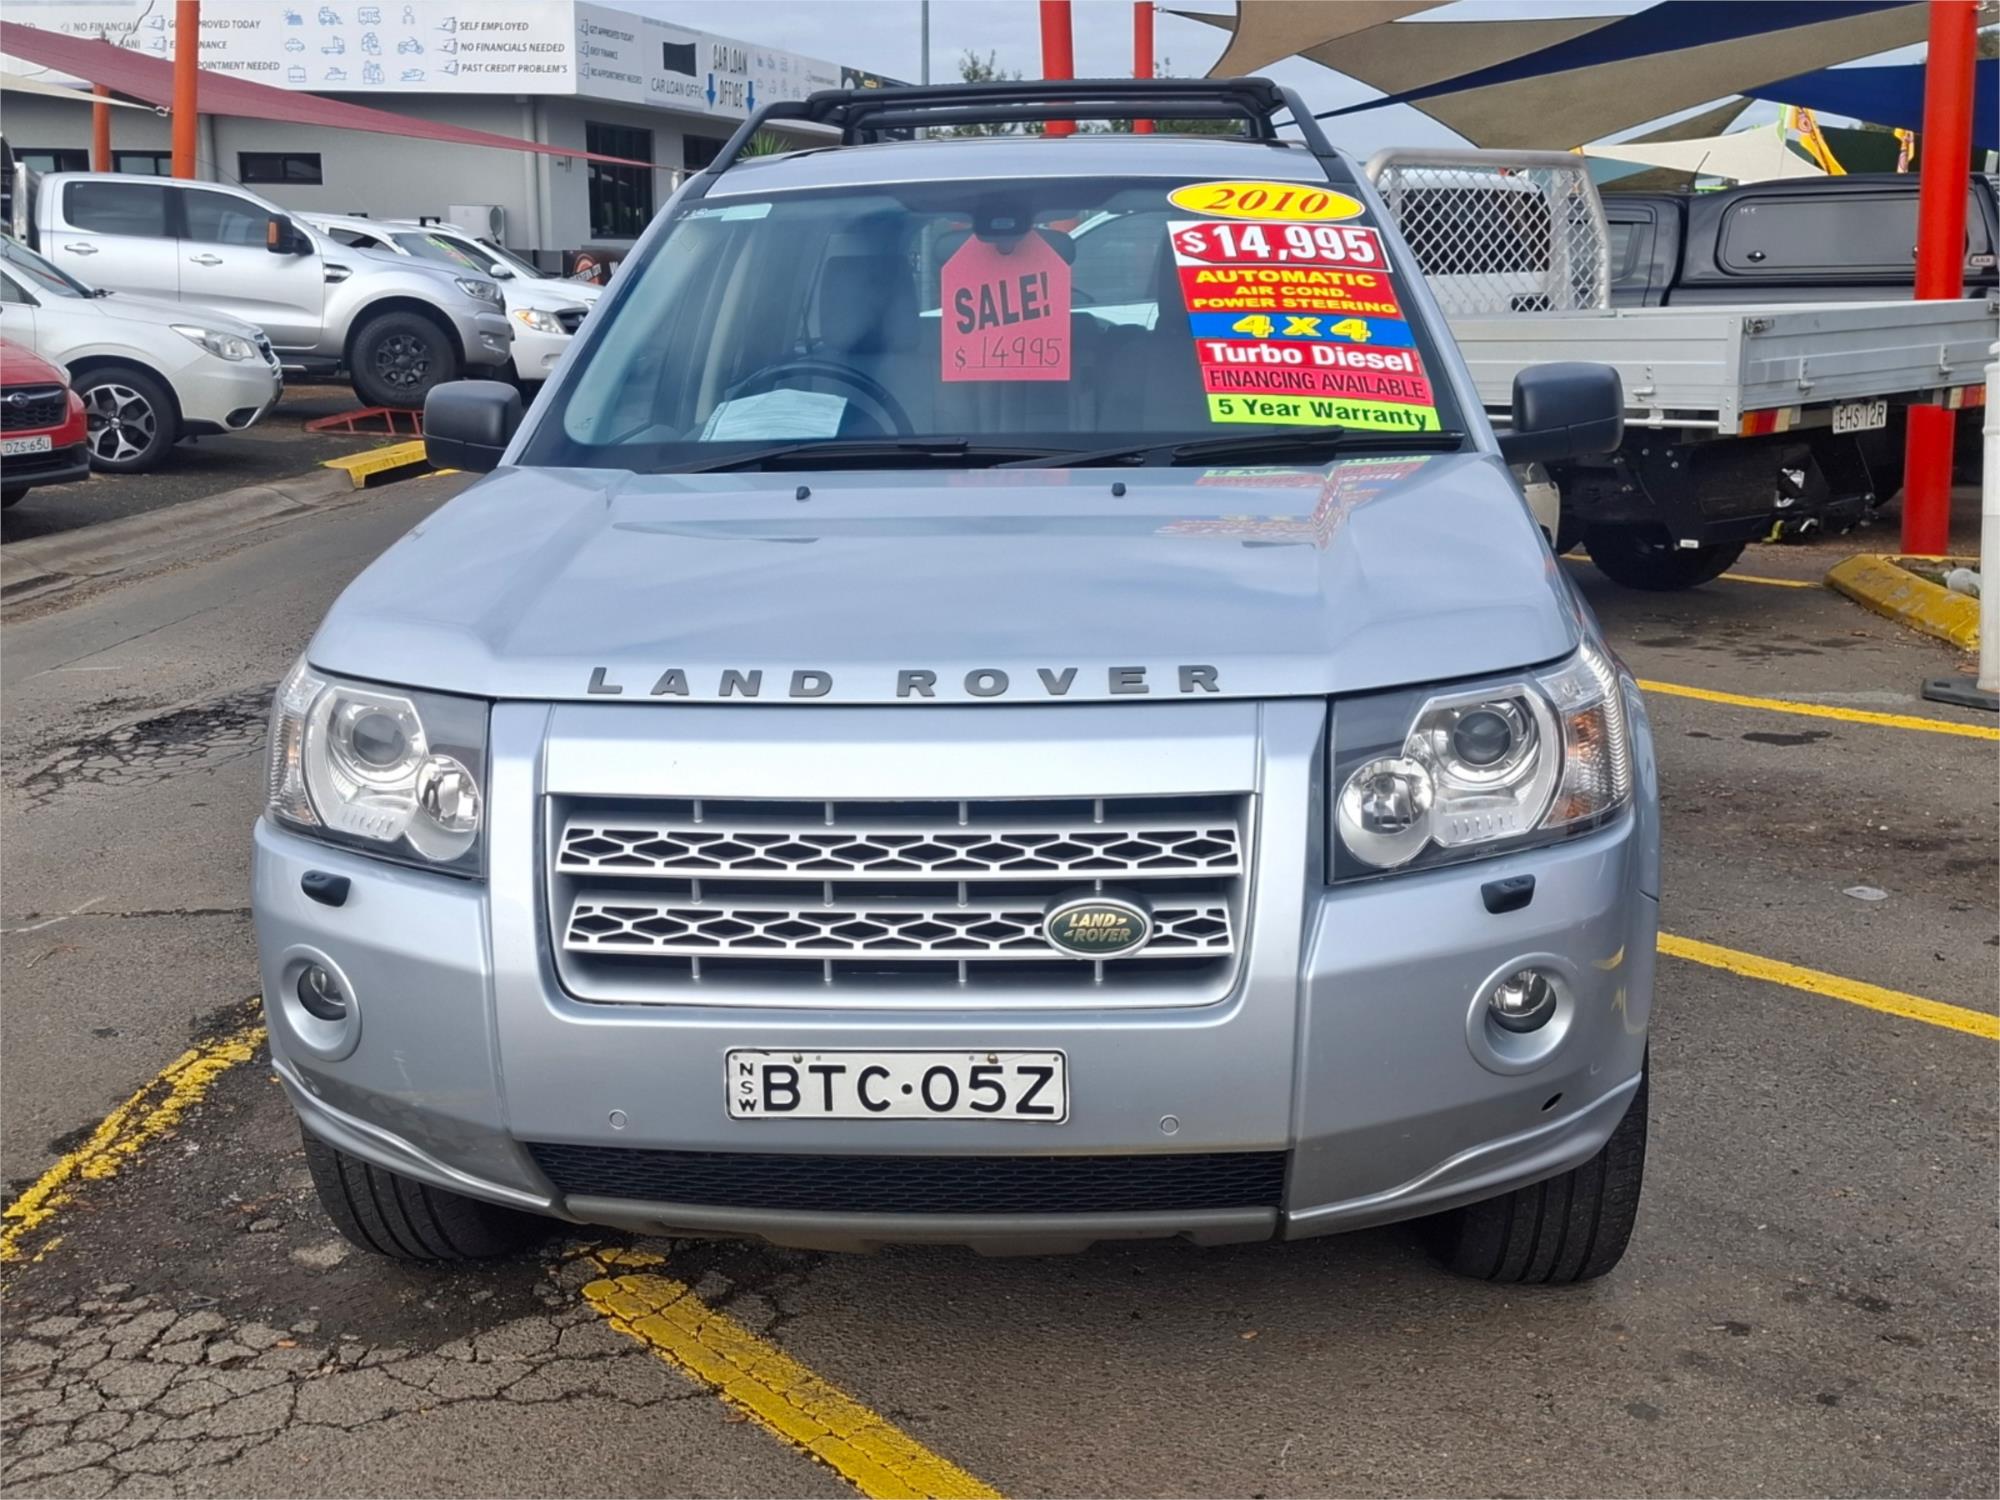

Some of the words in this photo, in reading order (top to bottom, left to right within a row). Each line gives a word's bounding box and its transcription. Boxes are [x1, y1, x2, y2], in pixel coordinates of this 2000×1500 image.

[73, 22, 87, 31] NO
[232, 20, 261, 28] TODAY
[460, 22, 479, 31] SELF
[481, 22, 529, 31] EMPLOYED
[461, 43, 474, 52] NO
[476, 43, 527, 52] FINANCIALS
[529, 43, 565, 52] NEEDED
[247, 62, 280, 70] NEEDED
[462, 64, 483, 73] PAST
[485, 64, 516, 73] CREDIT
[518, 64, 568, 73] PROBLEM'S
[713, 44, 728, 71] CAR
[729, 48, 747, 76] LOAN
[651, 77, 664, 92] CAR
[666, 79, 685, 96] LOAN
[720, 79, 743, 108] OFFICE
[1204, 188, 1330, 214] 2010
[1181, 225, 1376, 263] $14,995
[1196, 269, 1377, 288] AUTOMATIC
[1235, 286, 1275, 296] AIR
[1280, 286, 1353, 298] COND.
[954, 271, 1051, 335] SALE!
[1192, 297, 1276, 309] POWER
[1282, 298, 1398, 314] STEERING
[982, 335, 1063, 368] 14995
[1206, 342, 1303, 364] Turbo
[1312, 344, 1414, 373] Diesel
[1209, 370, 1316, 390] FINANCING
[1321, 372, 1427, 399] AVAILABLE
[1218, 398, 1235, 415] 5
[1242, 398, 1302, 418] Year
[1309, 400, 1427, 431] Warranty
[587, 666, 834, 698] LAND
[895, 664, 1221, 698] ROVER
[1069, 913, 1117, 928] LAND
[1074, 928, 1131, 942] ROVER
